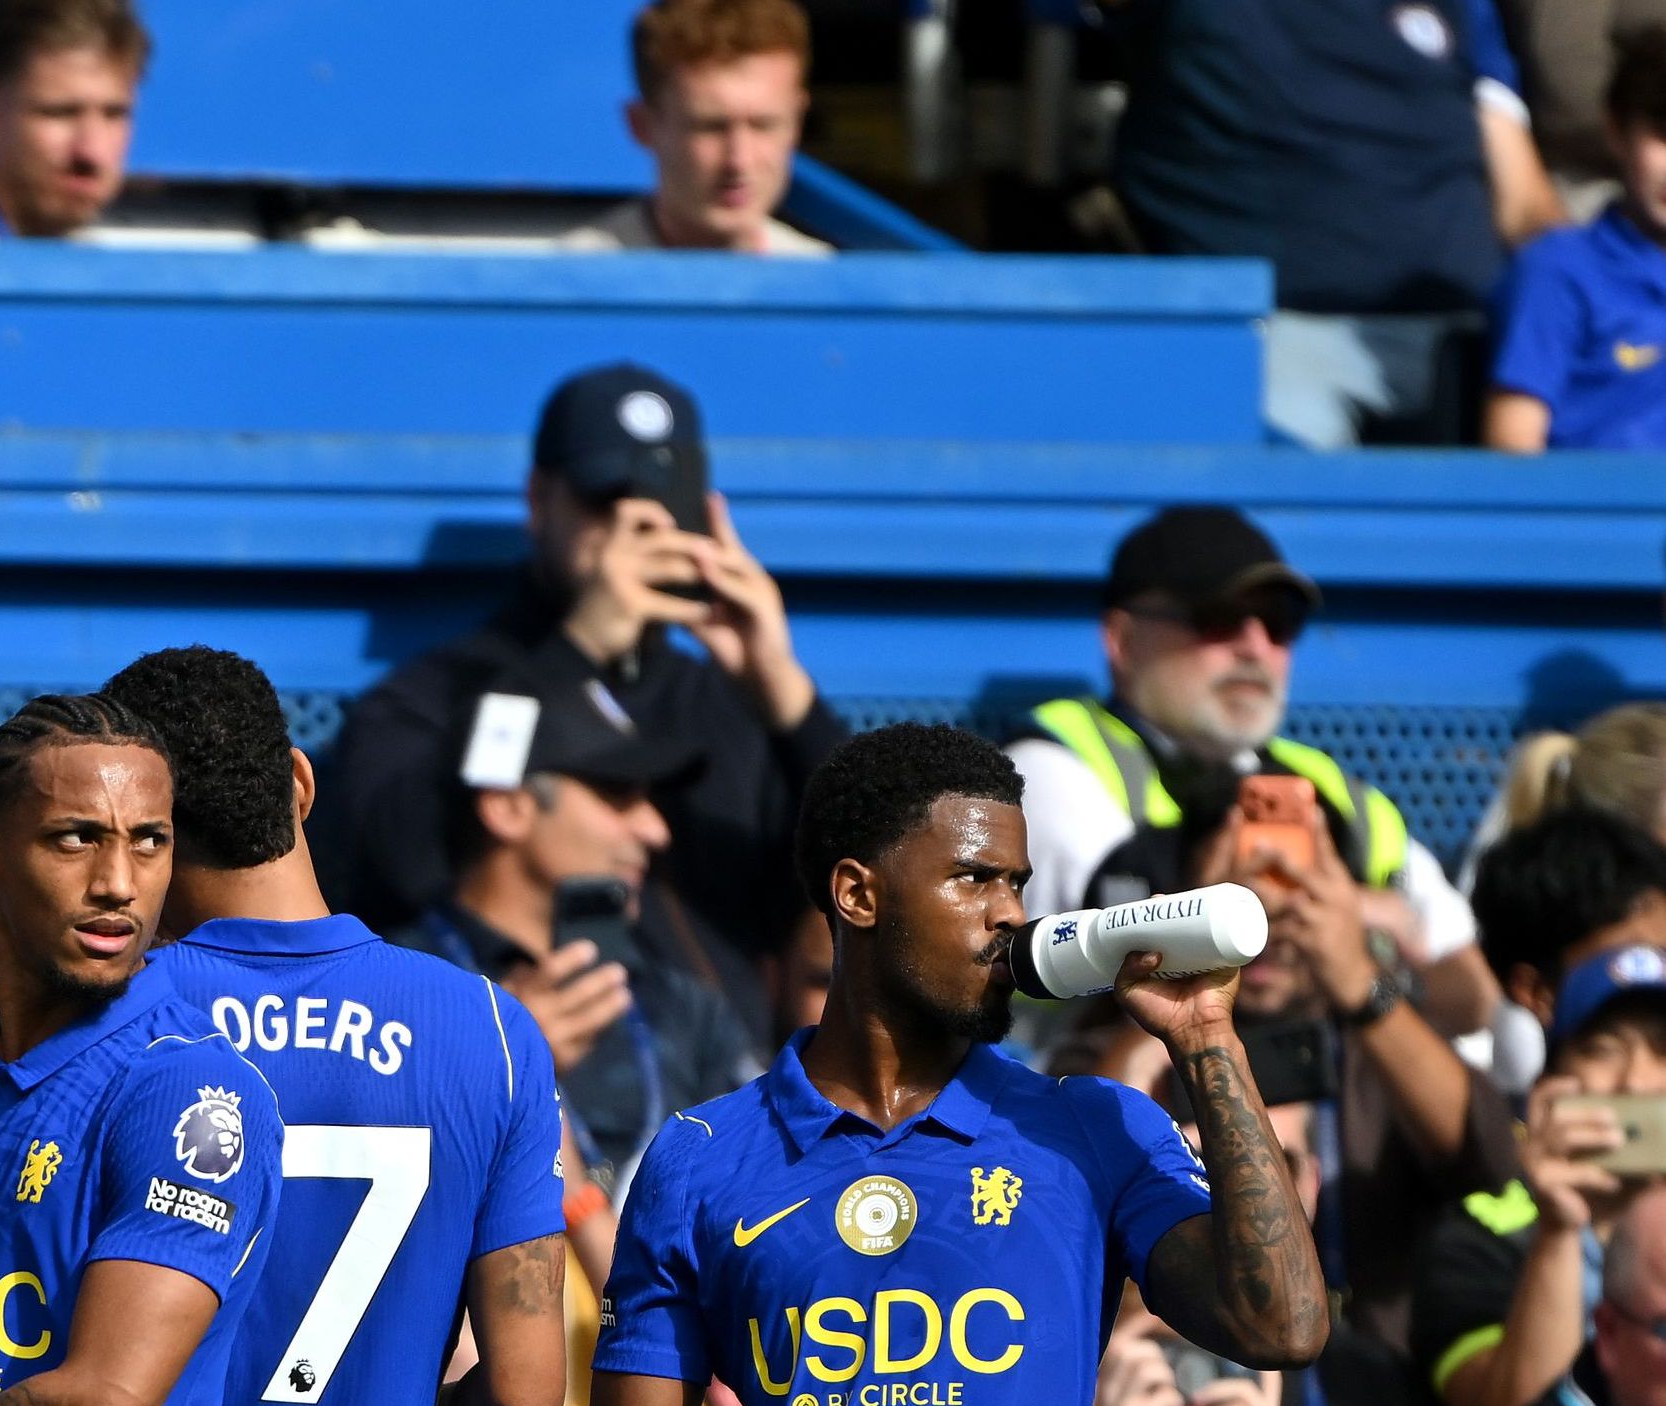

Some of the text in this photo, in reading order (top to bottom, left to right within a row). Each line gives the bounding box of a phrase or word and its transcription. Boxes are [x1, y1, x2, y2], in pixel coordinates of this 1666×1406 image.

[1106, 898, 1202, 931] HYDRATE
[212, 995, 412, 1075] OGERS
[145, 1195, 229, 1235] for racism
[151, 1176, 227, 1217] No room
[863, 1182, 909, 1221] CHAMPIONS
[862, 1235, 894, 1249] FIFA
[749, 1287, 1026, 1396] USDC
